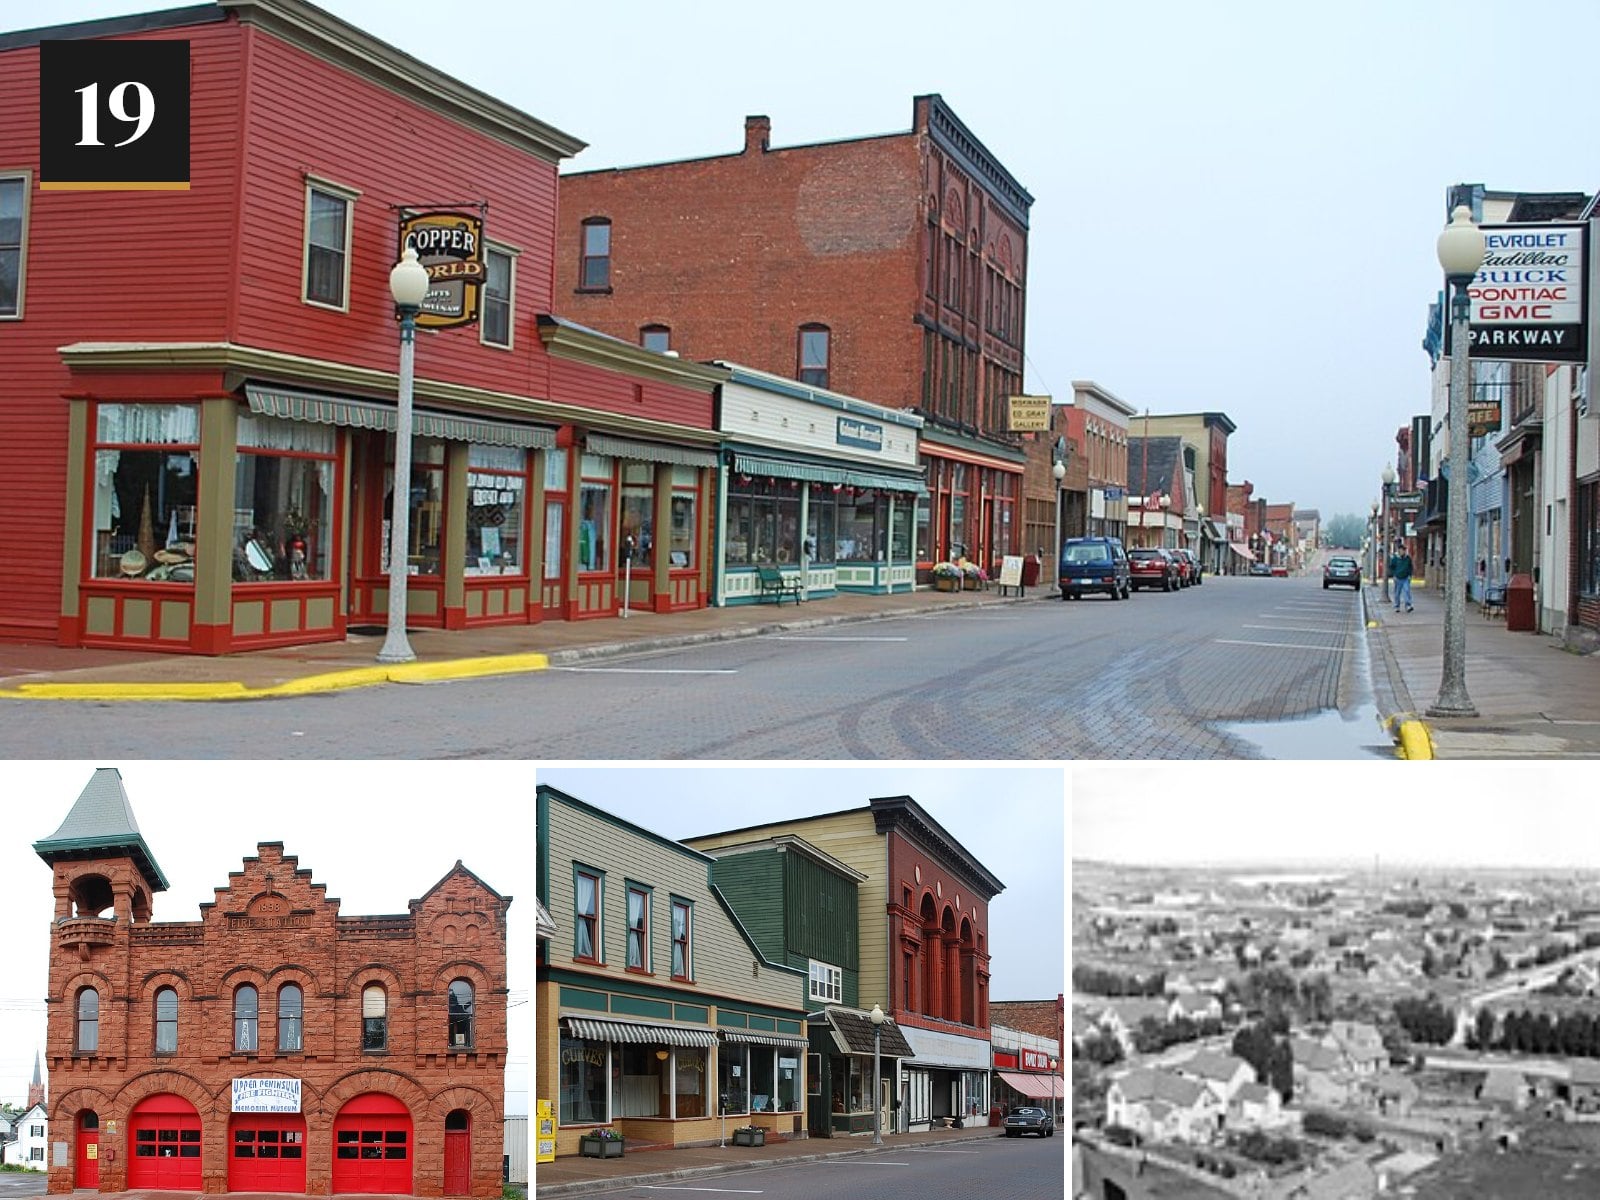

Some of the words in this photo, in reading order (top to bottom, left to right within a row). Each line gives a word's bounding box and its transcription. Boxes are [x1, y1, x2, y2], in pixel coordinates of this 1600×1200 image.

[406, 229, 474, 252] COPPER
[1485, 233, 1567, 248] EVROLET
[425, 262, 481, 278] ORLD
[1467, 287, 1567, 301] PONTIAC
[1479, 305, 1553, 319] GMC
[1468, 330, 1565, 345] PARKWAY
[1467, 410, 1493, 423] AFE
[562, 1047, 604, 1067] CURVES
